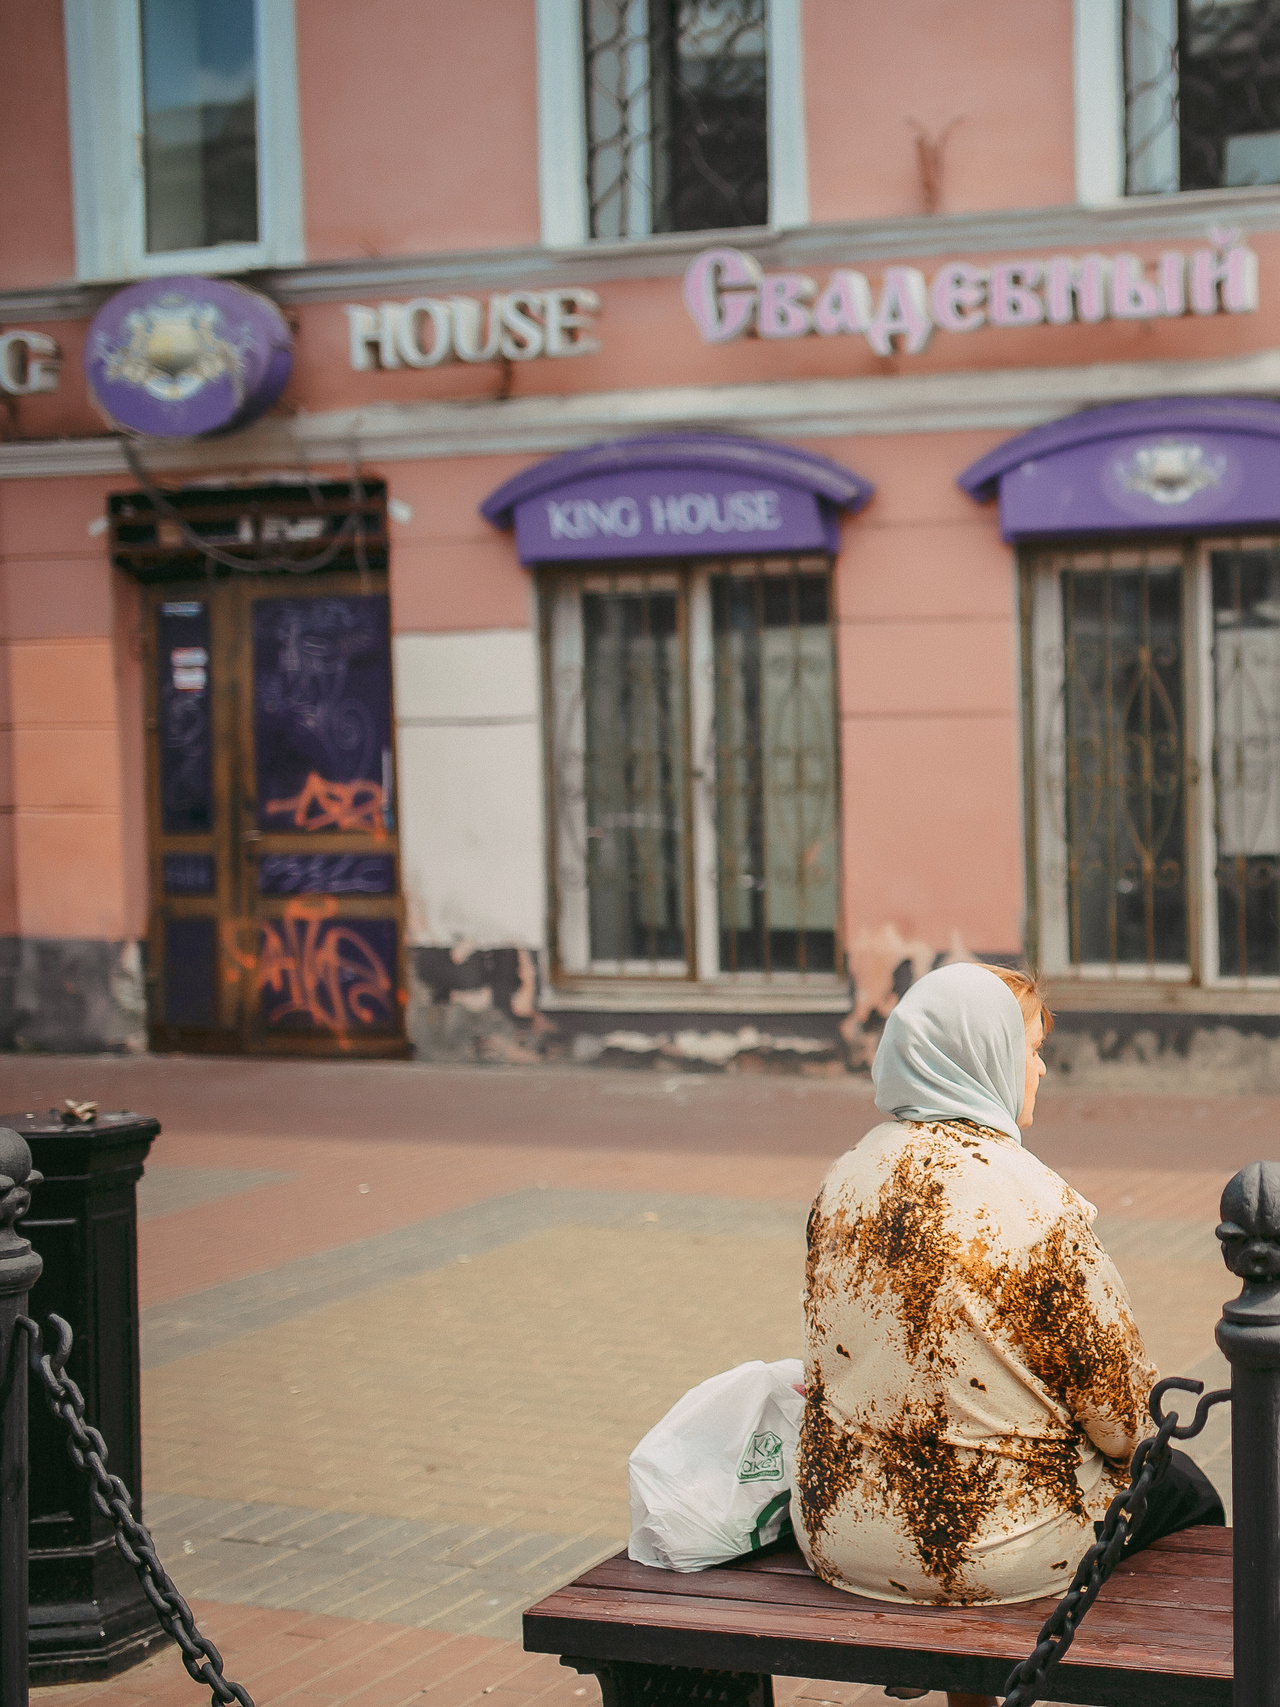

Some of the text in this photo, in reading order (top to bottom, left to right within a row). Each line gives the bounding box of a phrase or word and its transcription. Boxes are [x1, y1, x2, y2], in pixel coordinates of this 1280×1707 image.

[344, 286, 600, 372] HOUSE
[547, 489, 783, 540] KING HOUSE
